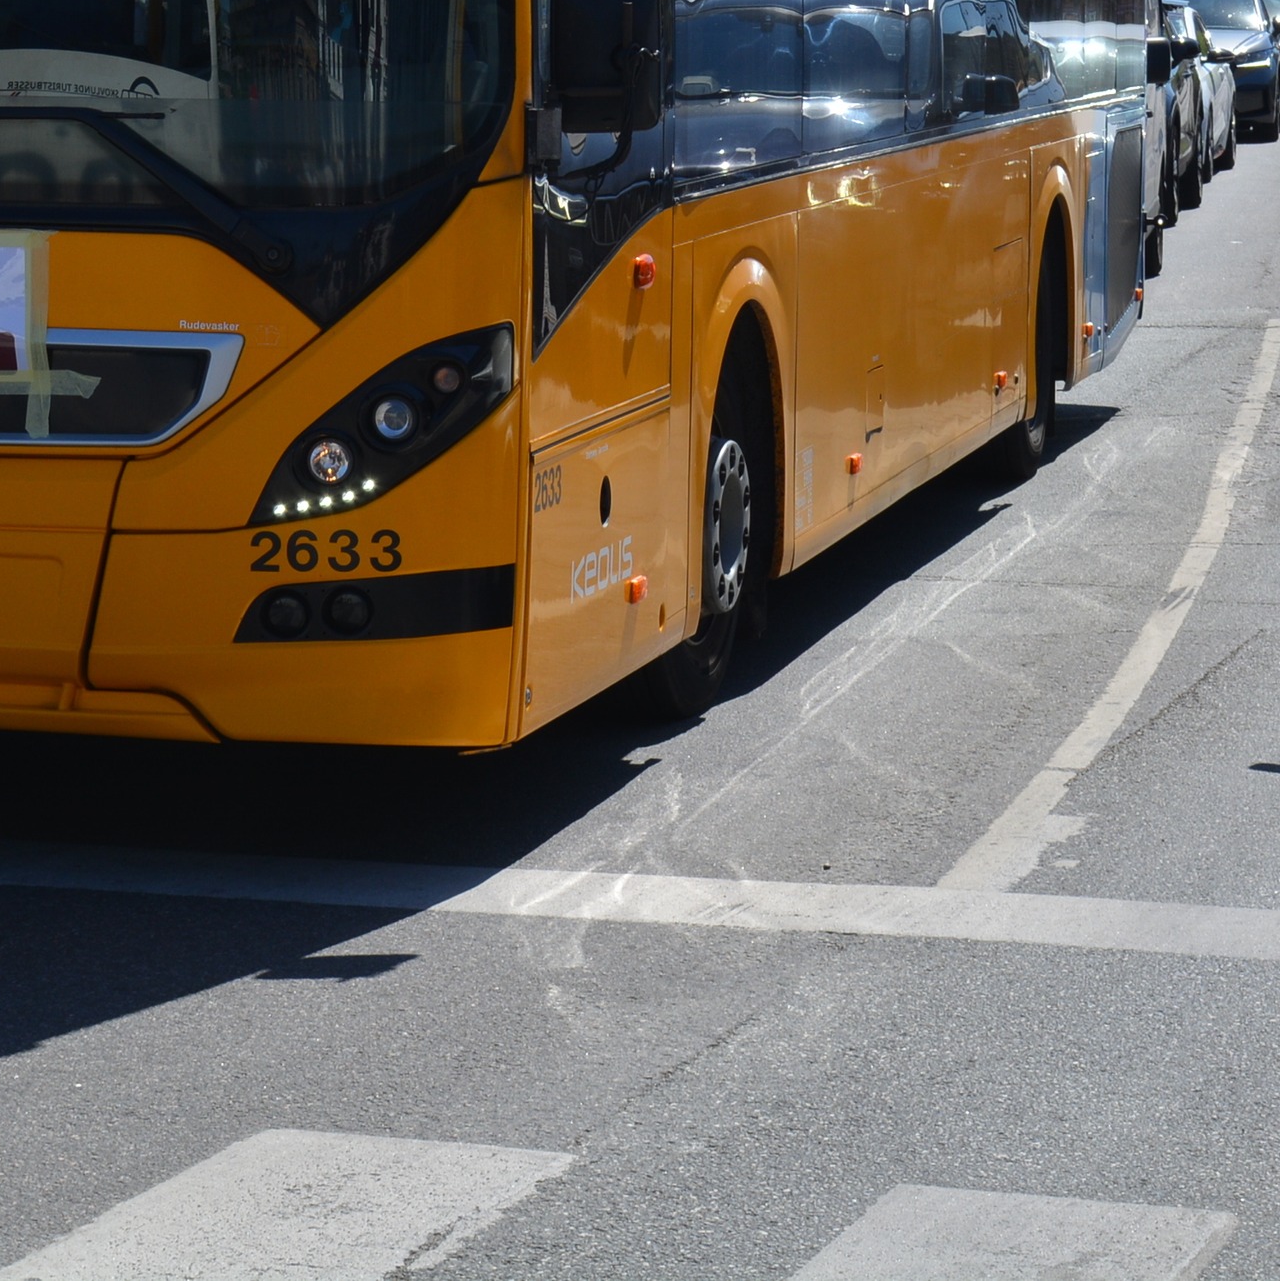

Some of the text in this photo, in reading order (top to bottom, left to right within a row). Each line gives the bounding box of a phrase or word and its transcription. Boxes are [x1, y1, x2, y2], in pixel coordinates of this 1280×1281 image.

[179, 319, 240, 331] Rudevasker
[533, 465, 562, 513] 2633
[249, 530, 403, 572] 2633
